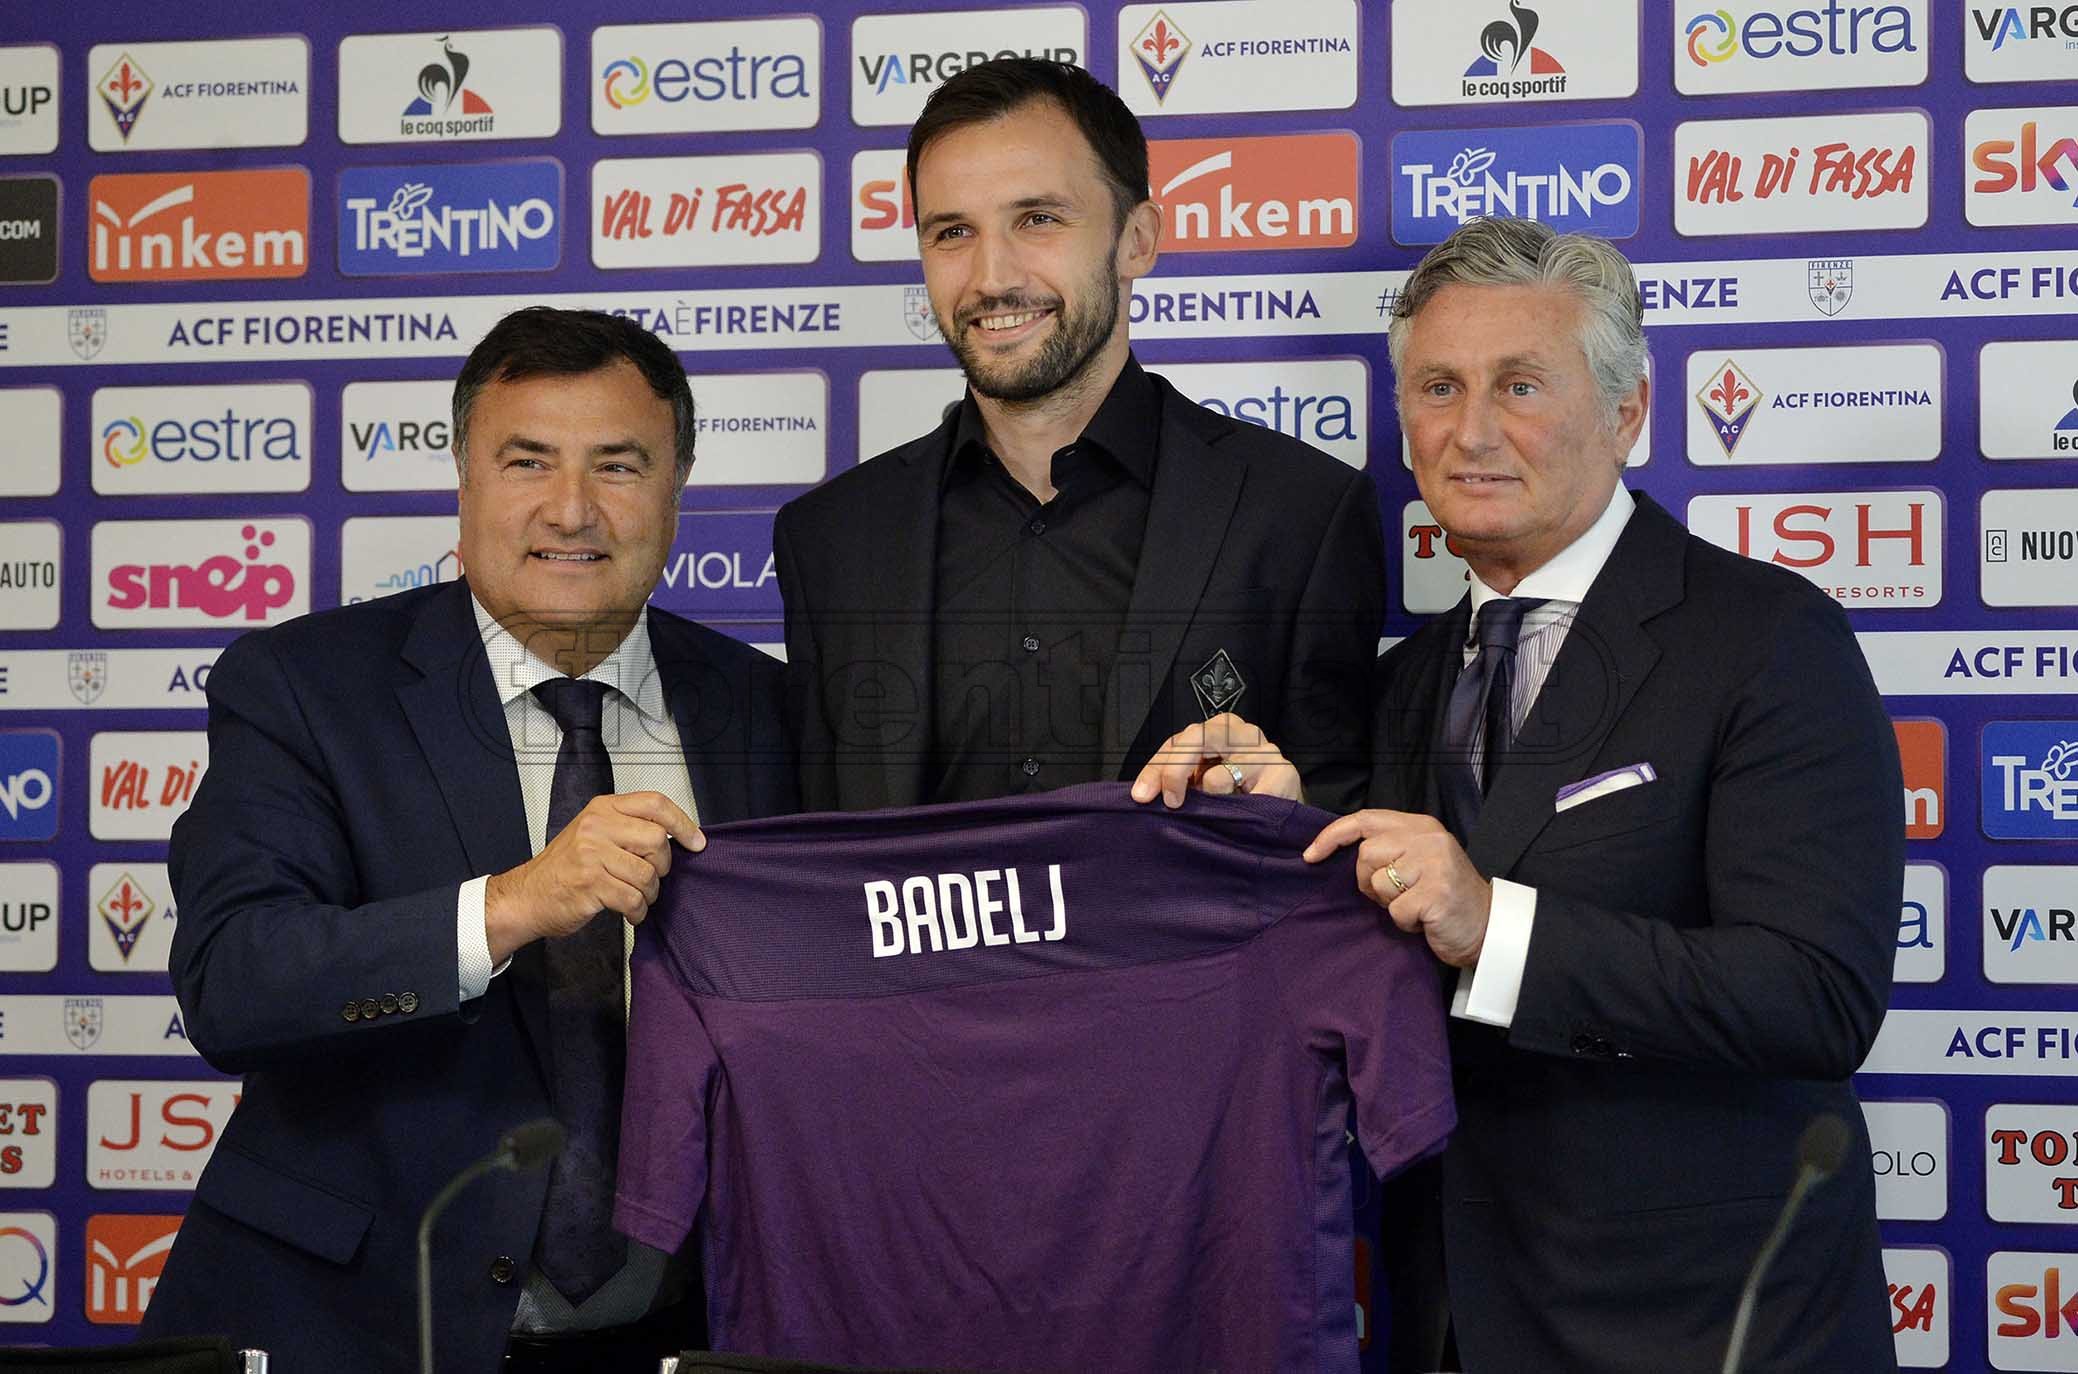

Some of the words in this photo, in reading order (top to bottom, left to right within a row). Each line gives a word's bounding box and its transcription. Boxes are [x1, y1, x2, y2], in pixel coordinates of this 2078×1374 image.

[1742, 0, 1917, 58] estra
[1201, 42, 1236, 58] ACF
[1241, 38, 1351, 56] FIORENTINA
[162, 84, 194, 98] ACF
[198, 80, 299, 97] FIORENTINA
[654, 46, 810, 101] estra
[1462, 80, 1477, 97] le
[1480, 81, 1509, 99] coq
[1512, 76, 1567, 97] sportif
[401, 118, 414, 135] le
[416, 121, 443, 138] coq
[445, 116, 494, 136] sportif
[1687, 149, 1744, 204] VAL
[1808, 142, 1916, 200] FASSA
[1400, 160, 1632, 224] TRENTINO
[96, 185, 304, 270] linkem
[346, 196, 554, 257] TRENTINO
[602, 190, 652, 239] VAL
[712, 183, 806, 237] FASSA
[1940, 268, 2022, 301] ACF
[168, 315, 233, 347] ACF
[244, 312, 458, 345] FIORENTINA
[1772, 393, 1809, 409] ACF
[1813, 390, 1932, 407] FIORENTINA
[151, 409, 302, 461] estra
[712, 416, 817, 432] FIORENTINA
[2053, 433, 2069, 450] le
[2021, 532, 2078, 561] NUO
[107, 555, 295, 620] snep
[1944, 647, 2024, 678] ACF
[2036, 646, 2078, 678] FI
[100, 760, 150, 809] VAL
[864, 864, 1066, 958] BADELJ
[1944, 1027, 2027, 1058] ACF
[2038, 1028, 2078, 1059] FI
[100, 1093, 242, 1152] JS
[1991, 1130, 2078, 1167] TO
[100, 1168, 175, 1182] HOTELS
